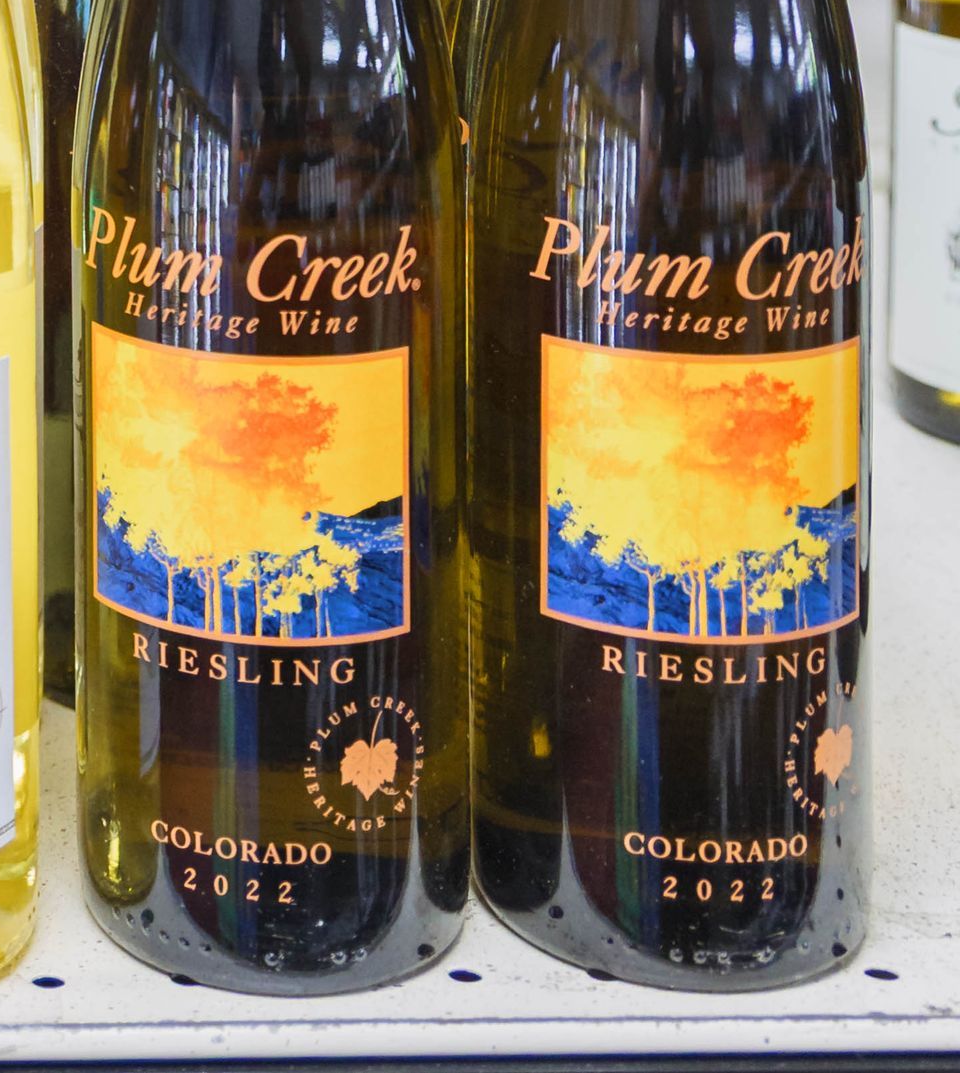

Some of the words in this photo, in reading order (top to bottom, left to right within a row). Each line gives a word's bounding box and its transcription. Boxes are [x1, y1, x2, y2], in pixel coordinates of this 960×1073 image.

[85, 206, 223, 297] Plum
[529, 216, 714, 301] Plum
[125, 291, 260, 339] Heritage
[280, 310, 358, 335] Wine
[596, 299, 748, 340] Heritage
[767, 307, 831, 332] Wine
[133, 632, 355, 686] RIESLING
[602, 644, 826, 684] RIESLING
[310, 701, 358, 752] PLUM
[370, 696, 421, 735] CREEK
[789, 690, 827, 745] PLUM
[303, 766, 386, 832] HERITAGE
[151, 820, 332, 866] COLORADO
[623, 831, 808, 864] COLORADO
[184, 868, 294, 905] 2022
[662, 876, 775, 903] 2022
